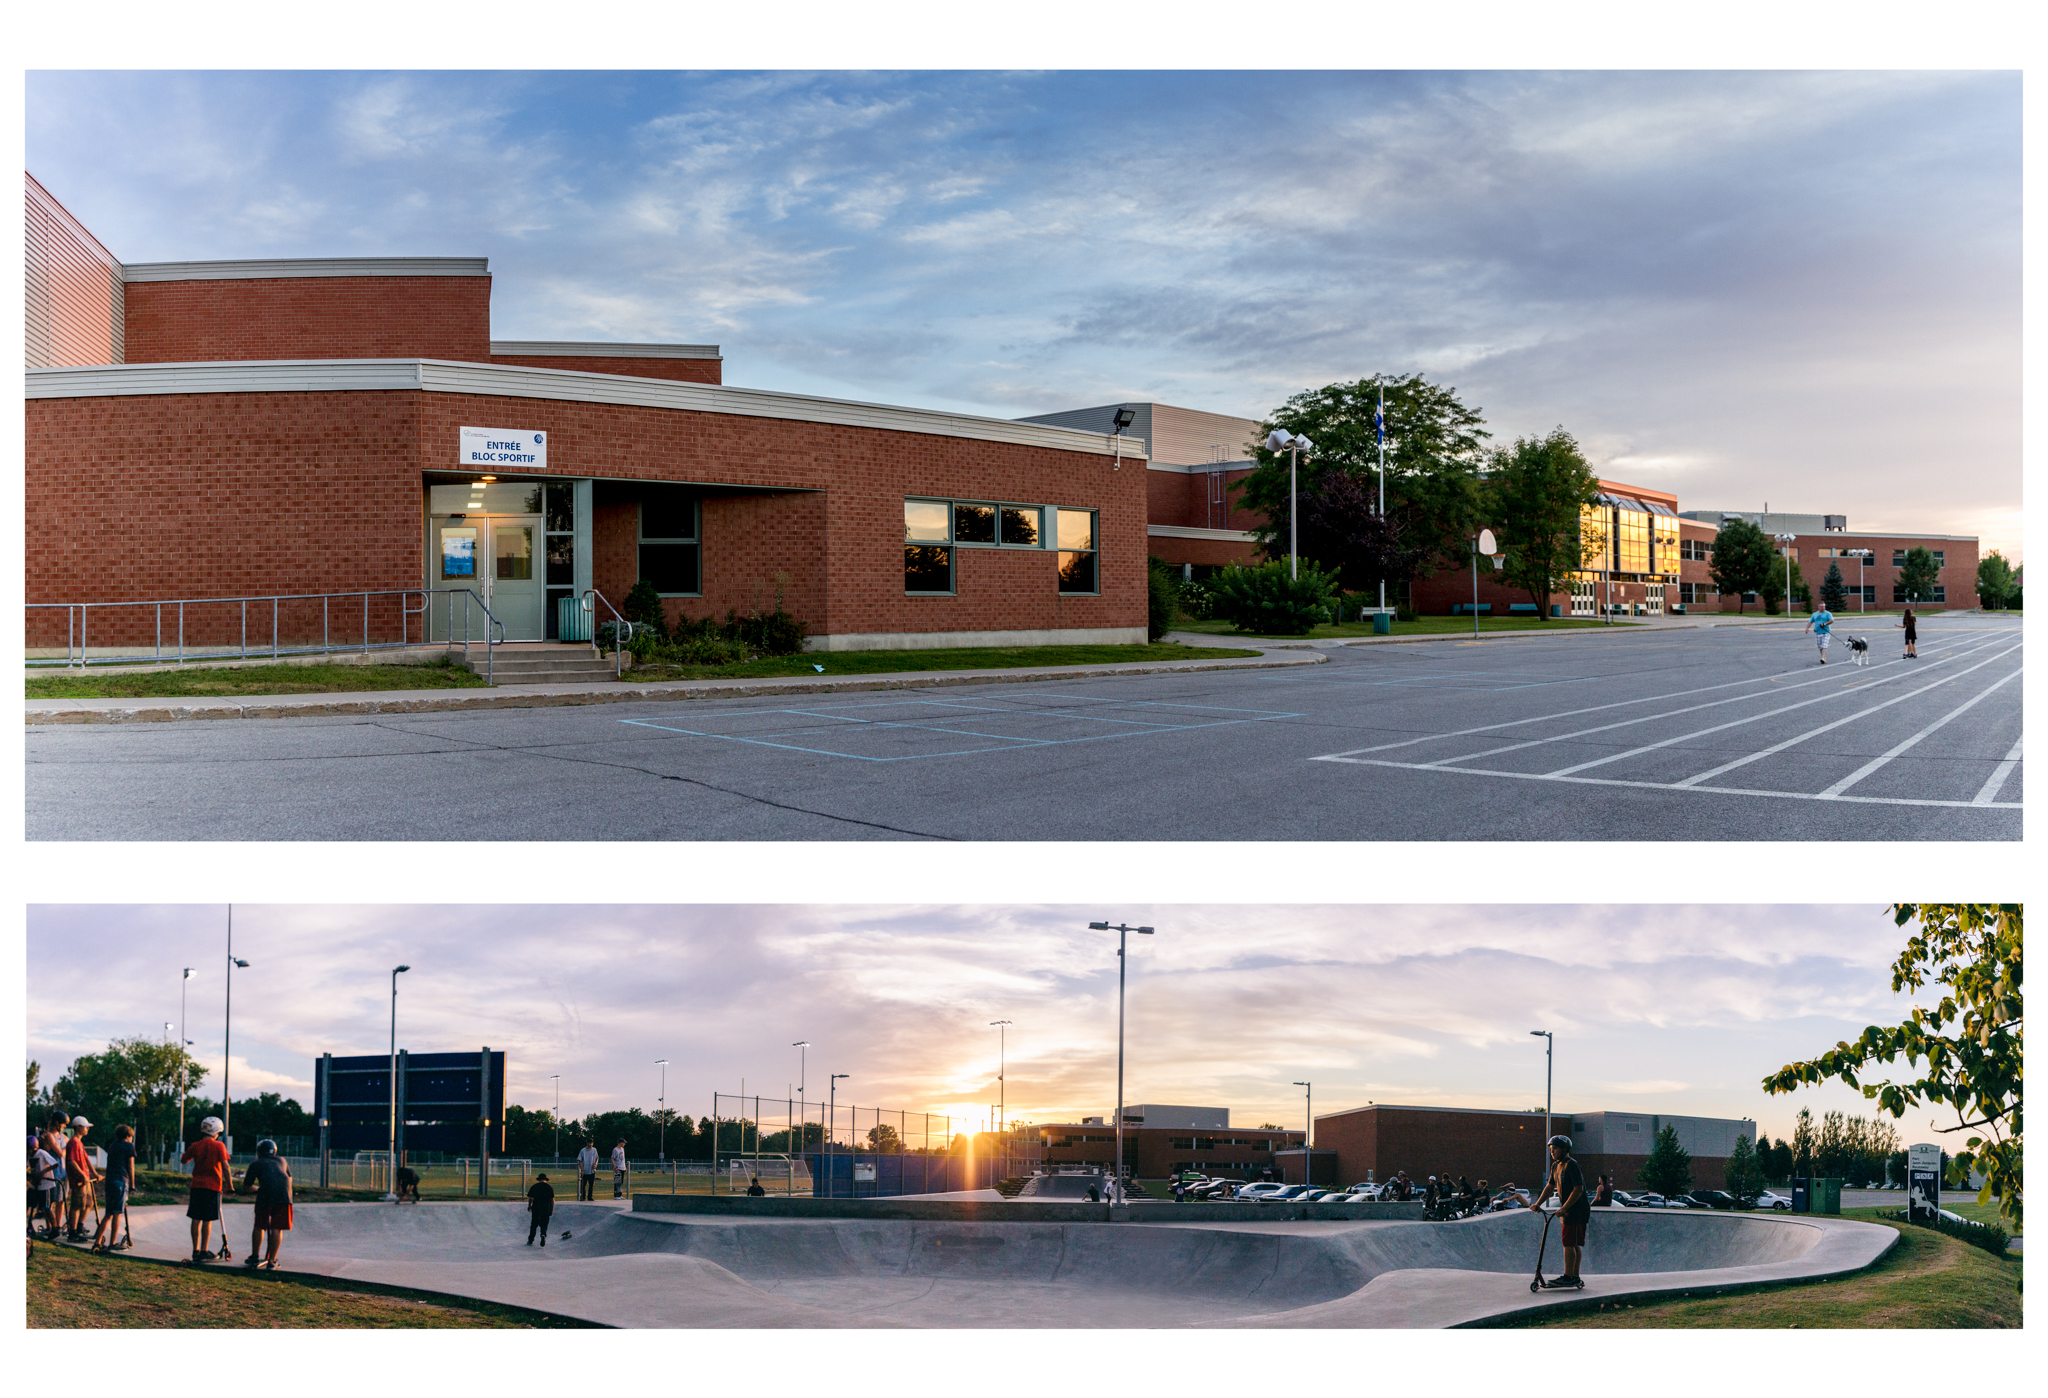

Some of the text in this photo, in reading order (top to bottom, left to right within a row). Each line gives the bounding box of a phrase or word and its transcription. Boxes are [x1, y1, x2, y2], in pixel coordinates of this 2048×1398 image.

[487, 441, 521, 451] ENTRÉE
[472, 452, 535, 463] BLOC SPORTIF
